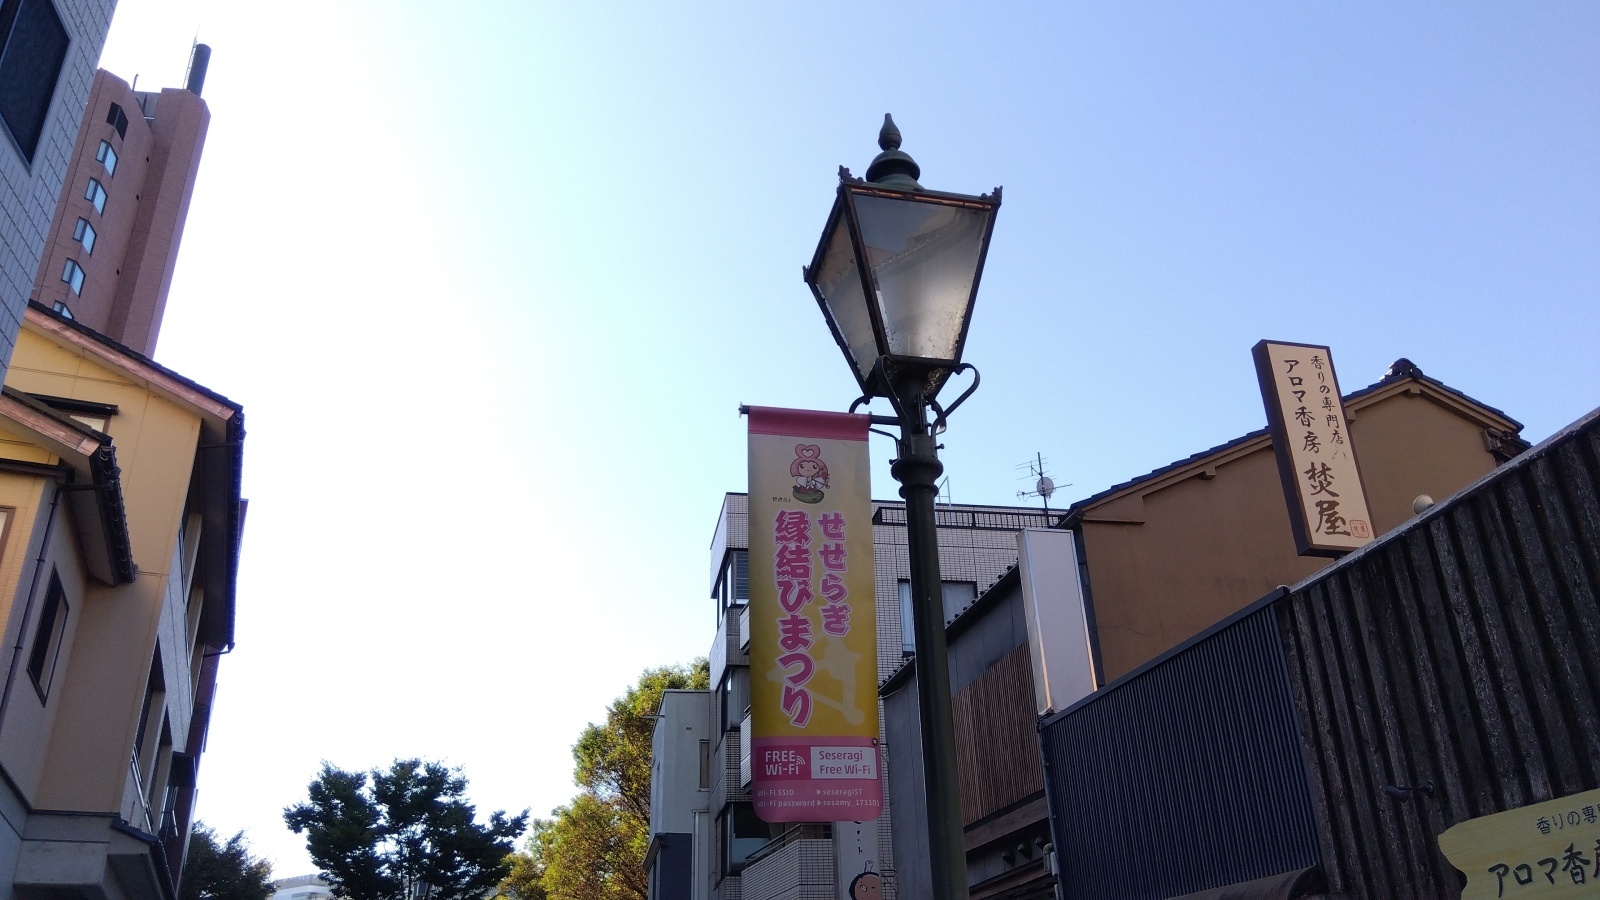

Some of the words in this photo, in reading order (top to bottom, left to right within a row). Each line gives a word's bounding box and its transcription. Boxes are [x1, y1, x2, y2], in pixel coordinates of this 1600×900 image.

[1310, 355, 1344, 445] 香りの専門店
[817, 511, 851, 637] せせらぎ
[774, 509, 815, 728] 縁結びまつり
[765, 750, 796, 763] FREE
[819, 750, 863, 762] Seseragi
[765, 763, 799, 776] Wi-Fi
[819, 764, 843, 775] Free
[844, 764, 871, 775] Wi-Fi
[757, 789, 776, 797] Wi-Fi
[757, 800, 776, 808] Wi-Fi
[778, 799, 815, 808] password
